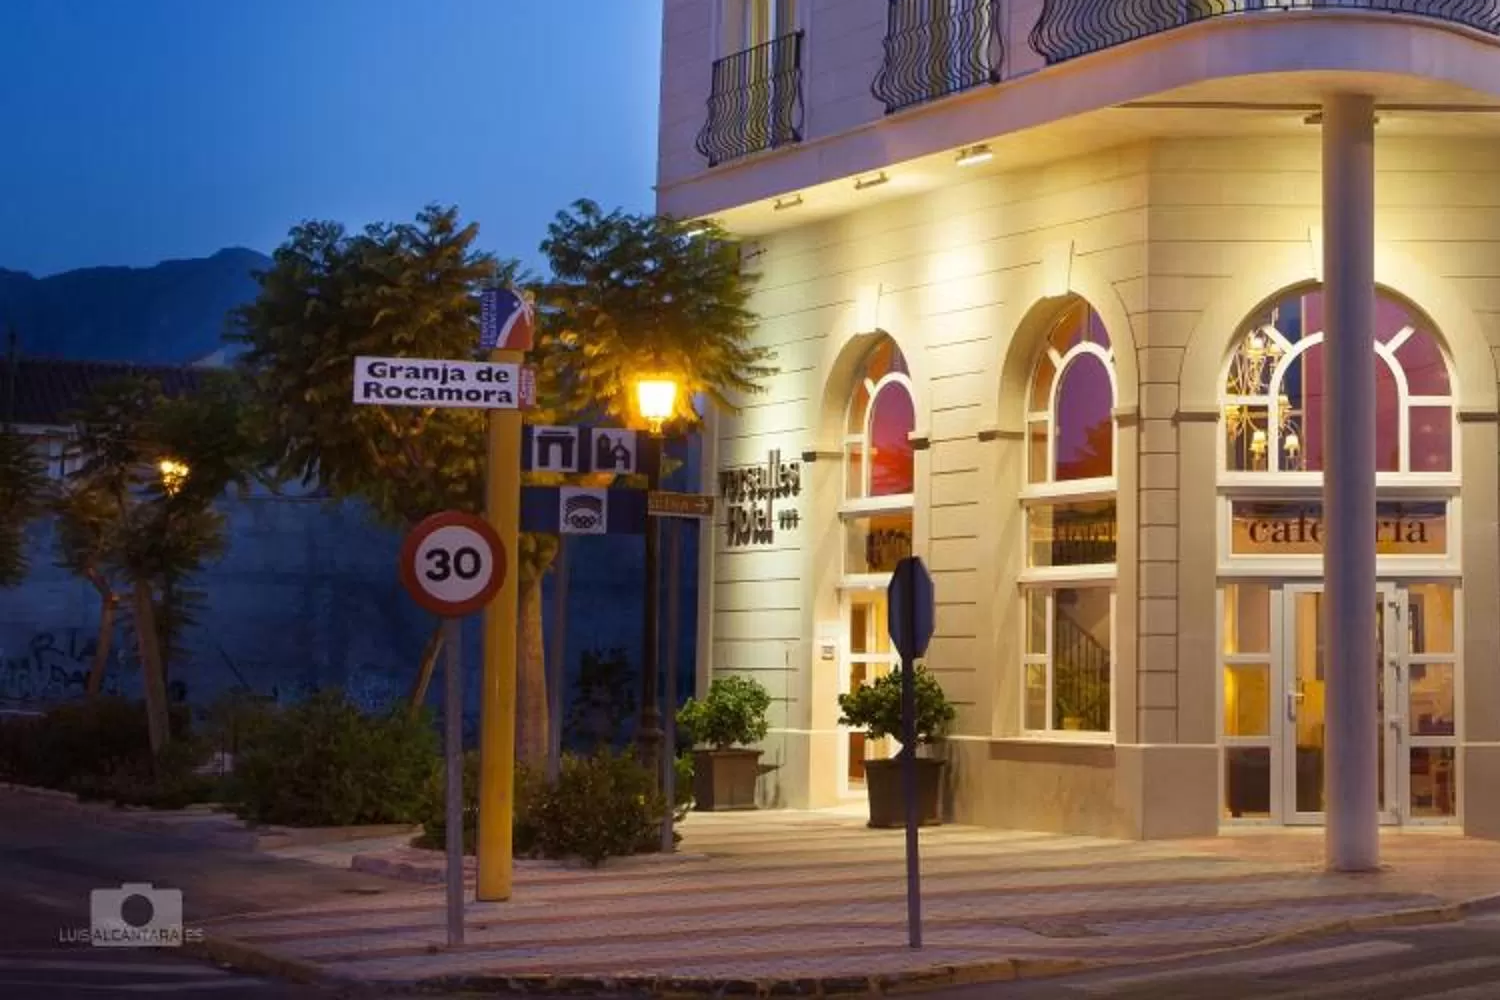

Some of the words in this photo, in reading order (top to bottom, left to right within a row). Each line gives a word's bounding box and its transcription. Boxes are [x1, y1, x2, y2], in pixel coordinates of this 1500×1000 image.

[367, 361, 466, 385] Granja
[476, 366, 510, 383] de
[363, 381, 513, 404] Rocamora
[1249, 511, 1428, 544] caferia
[425, 547, 482, 582] 30
